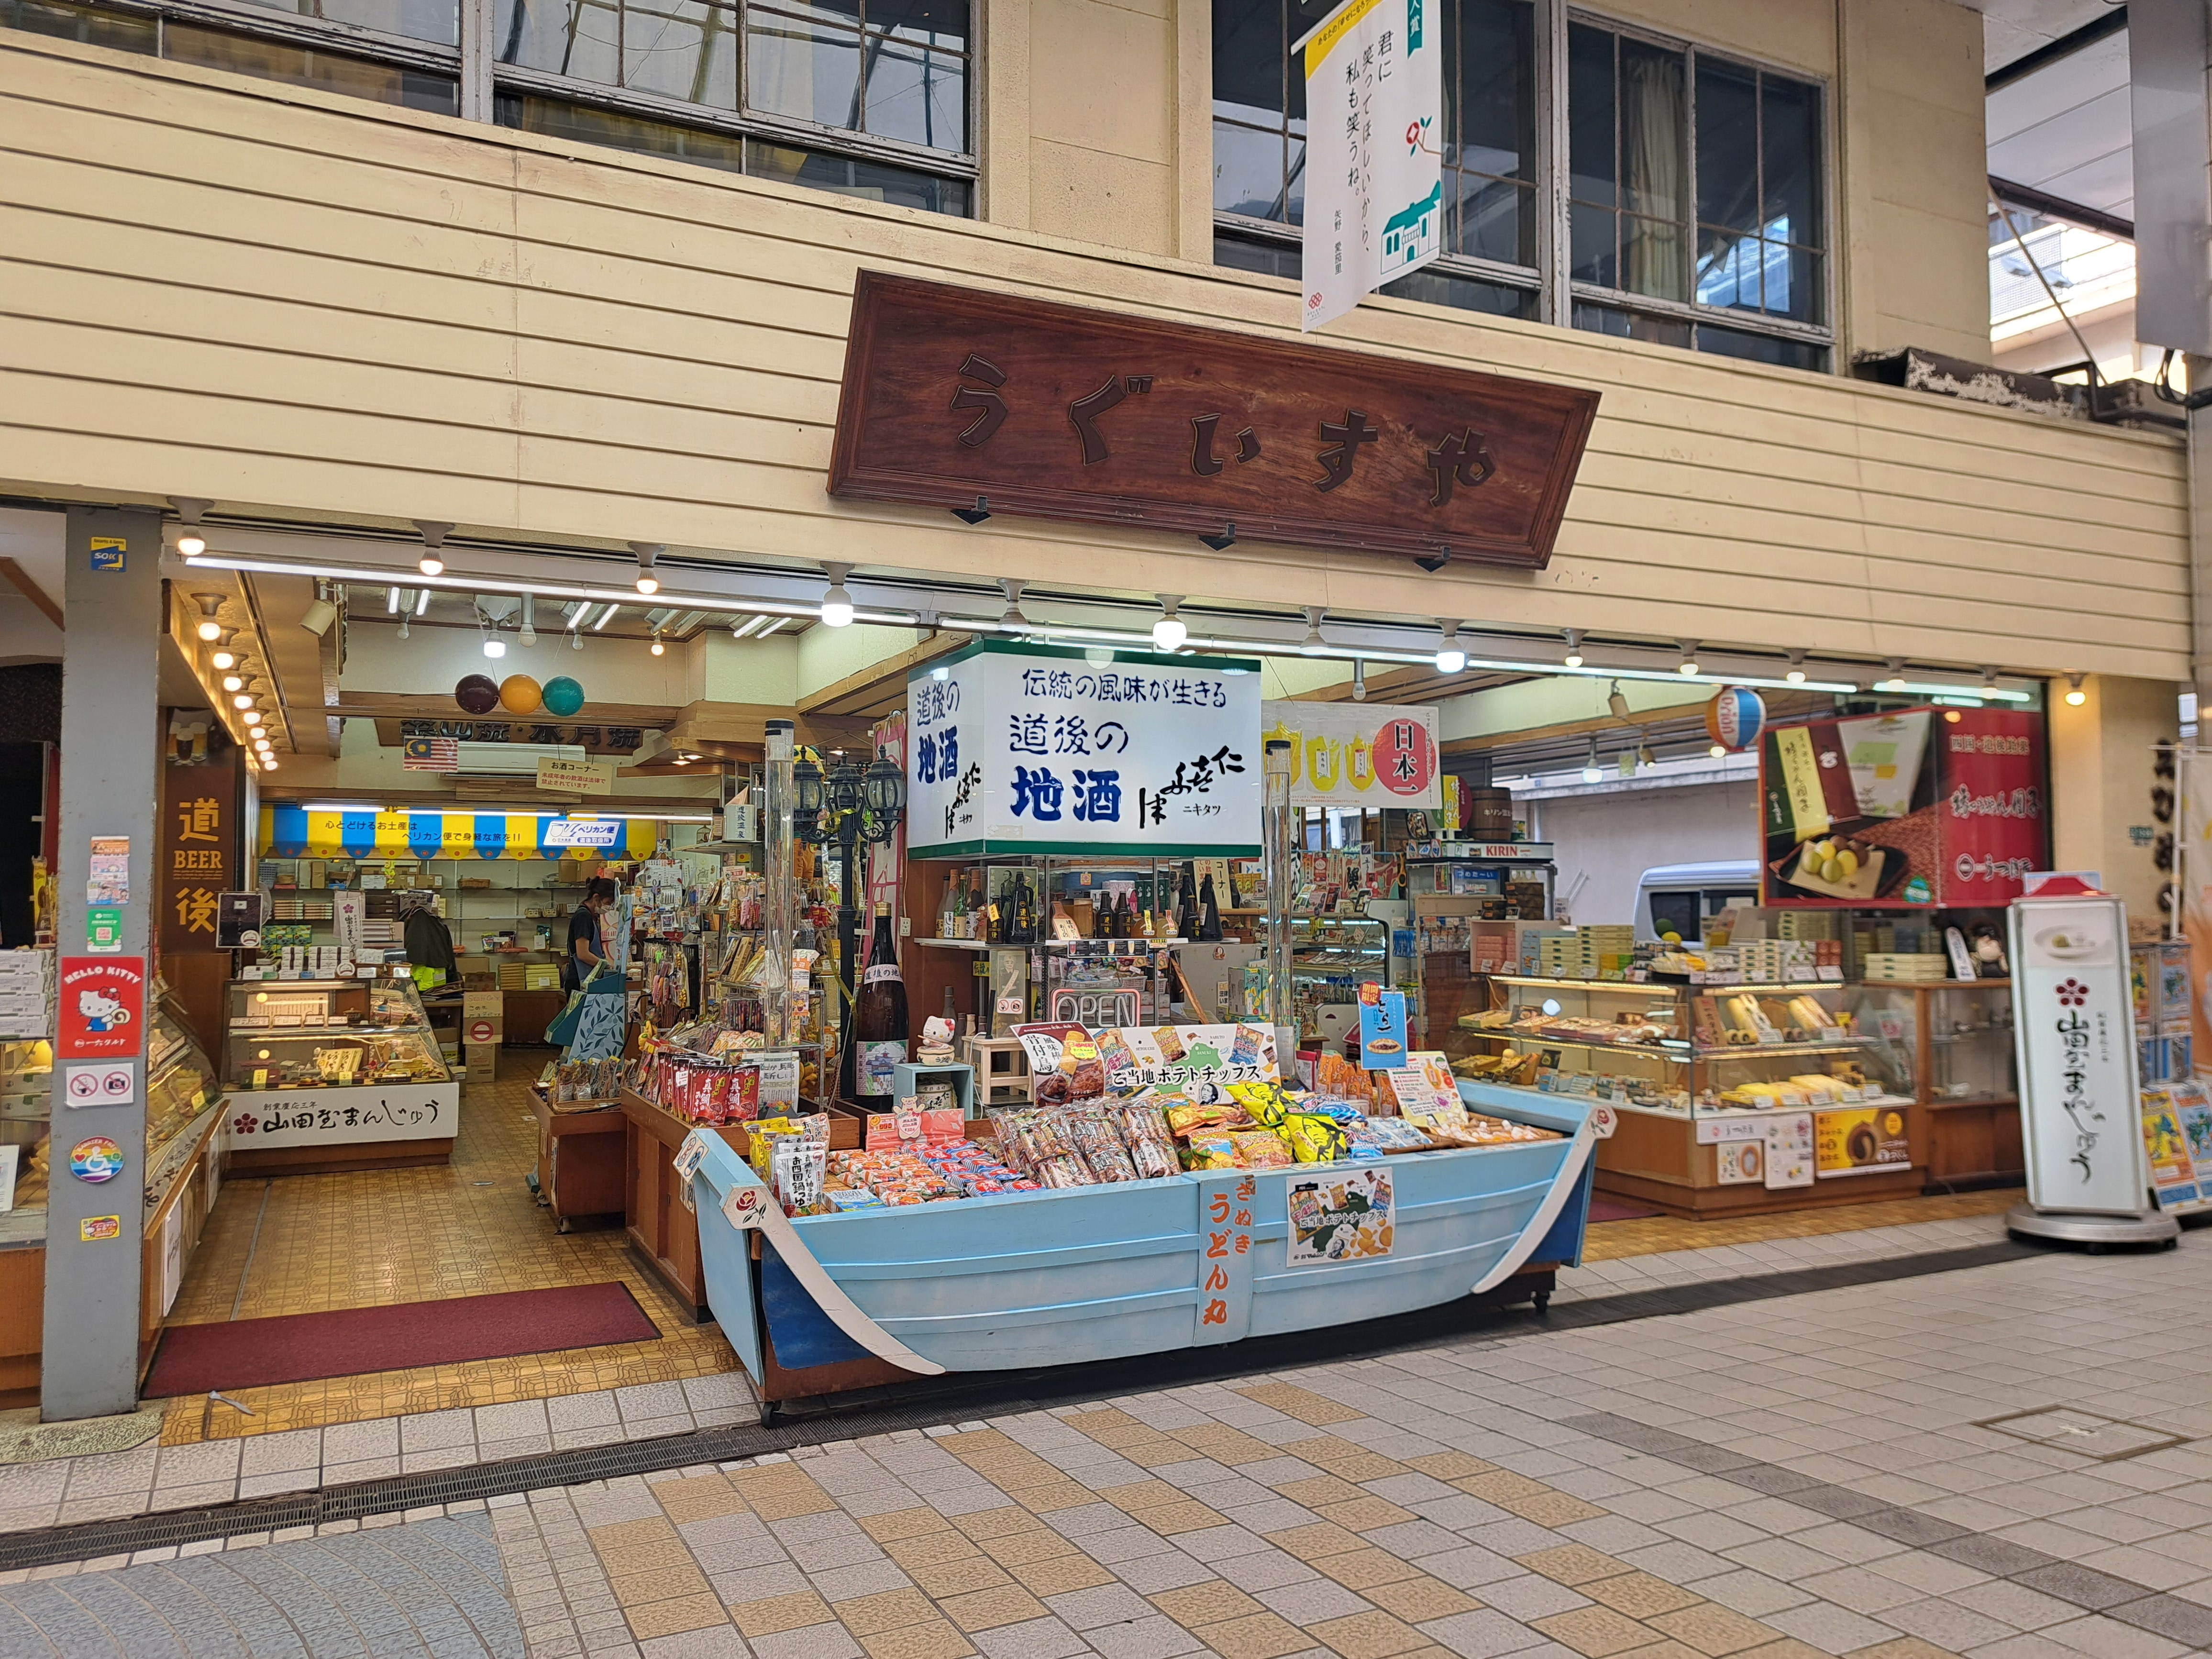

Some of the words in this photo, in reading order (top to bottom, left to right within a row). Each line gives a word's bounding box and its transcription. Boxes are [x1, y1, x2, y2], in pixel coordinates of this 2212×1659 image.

[1378, 30, 1394, 82] 君に
[1345, 59, 1360, 196] 私も笑うね。
[1361, 43, 1374, 253] 笑ってほしいから、
[950, 353, 1497, 508] うぐいすや
[917, 681, 960, 727] 道後の
[1023, 668, 1226, 708] 伝統の風味が生きる
[1010, 714, 1129, 755] 道後の
[551, 762, 599, 772] お酒コーナー
[918, 725, 957, 783] 地酒
[1393, 722, 1417, 793] 日本一
[542, 773, 606, 784] 未成年者の飲酒は法律で
[542, 779, 590, 789] 禁止されています。
[1010, 766, 1122, 822] 地酒
[179, 797, 219, 842] 道
[325, 821, 418, 830] 心とどけるお土産は
[1183, 805, 1221, 816] ニキタツ
[174, 850, 223, 868] BEER
[1486, 846, 1517, 856] KIRIN
[176, 887, 218, 933] 後
[1019, 908, 1028, 929] 道後
[64, 966, 103, 984] HELLO
[107, 966, 141, 984] KITTY
[865, 968, 903, 980] 道後の地
[1362, 984, 1378, 993] 期間
[1056, 995, 1135, 1027] OPEN
[1361, 993, 1378, 1003] 限定
[1026, 1035, 1052, 1071] 骨付鳥
[1043, 1037, 1062, 1060] 風味棒
[1113, 1063, 1261, 1085] ご当地ポテトチップス
[263, 1102, 318, 1111] 創業慶応三年
[700, 1078, 712, 1110] 真鯛の
[728, 1078, 741, 1110] 真鯛の
[263, 1099, 439, 1133] 山田屋まんじゅう
[77, 1139, 102, 1151] BARRIER
[104, 1140, 119, 1151] FREE
[792, 1156, 805, 1206] お四国鍋つゆ
[1234, 1183, 1252, 1254] さぬき
[1300, 1211, 1384, 1228] ご当地ポテトチップス
[1202, 1193, 1233, 1325] うどん丸
